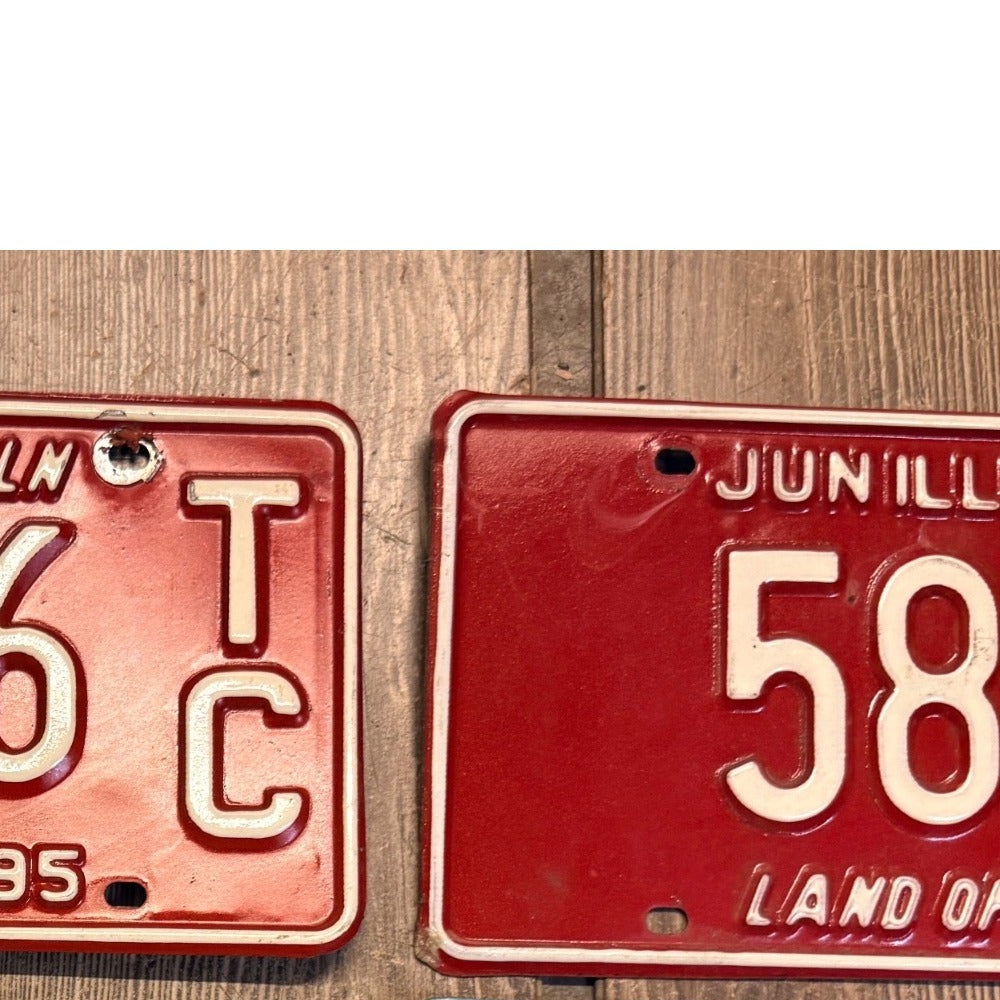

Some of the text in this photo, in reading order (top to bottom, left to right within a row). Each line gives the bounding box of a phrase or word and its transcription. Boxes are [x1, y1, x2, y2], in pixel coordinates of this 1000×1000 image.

[716, 448, 870, 502] JUN
[726, 551, 1000, 825] 58
[746, 874, 922, 930] LAND
